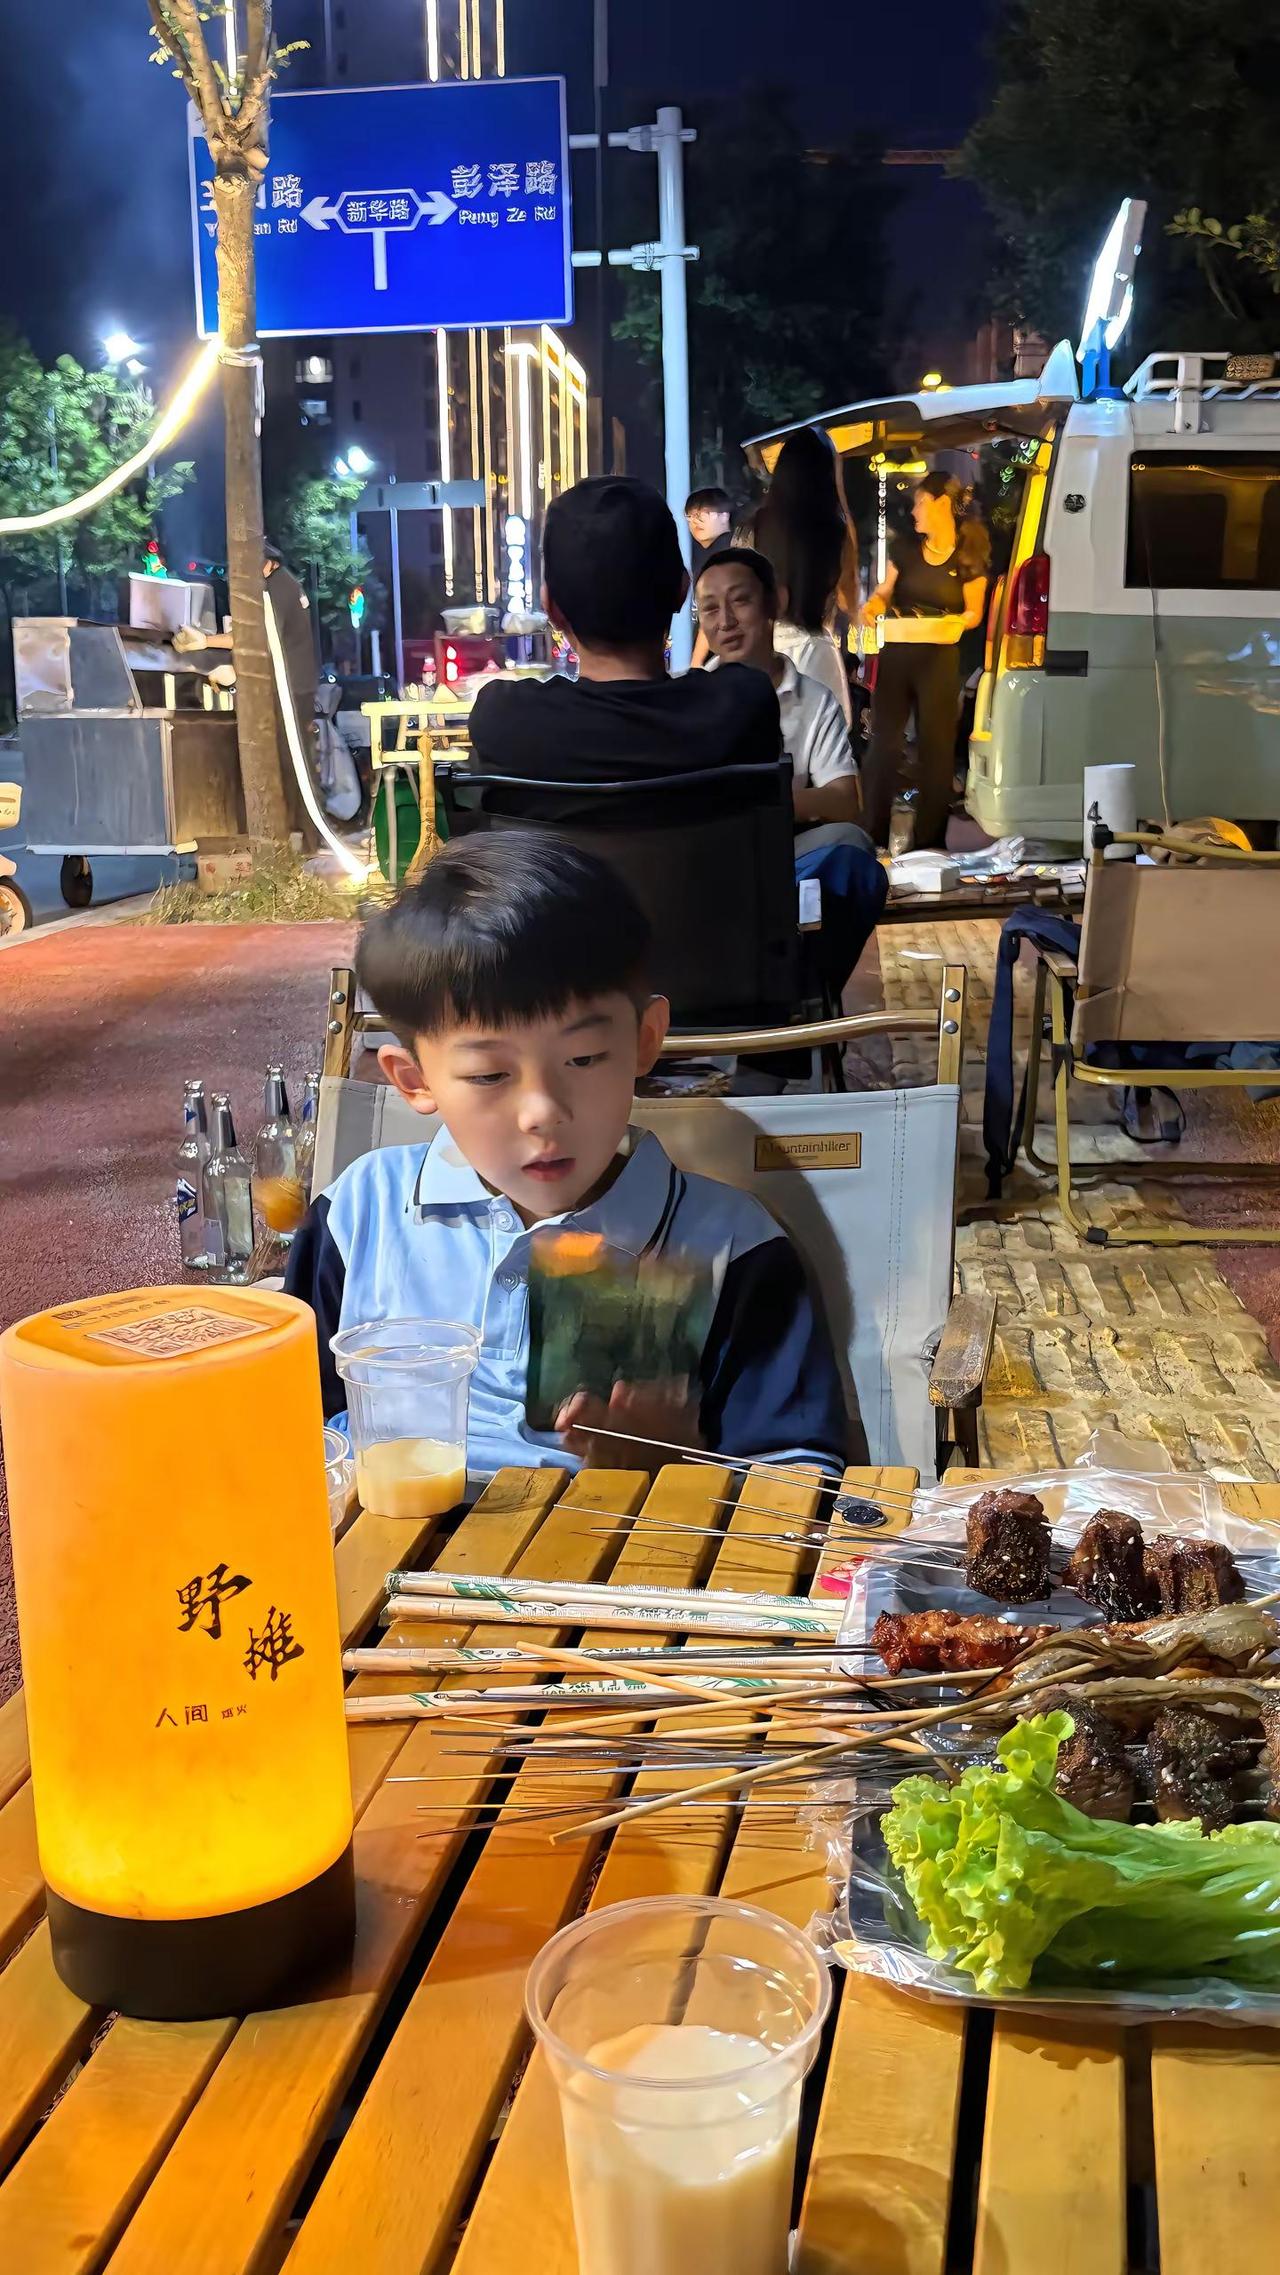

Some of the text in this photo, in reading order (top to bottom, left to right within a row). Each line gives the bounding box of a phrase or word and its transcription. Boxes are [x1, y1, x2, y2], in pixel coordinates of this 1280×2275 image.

[450, 161, 557, 198] 彭泽路
[346, 199, 410, 222] 新华路
[459, 205, 556, 228] Peng Ze Rd
